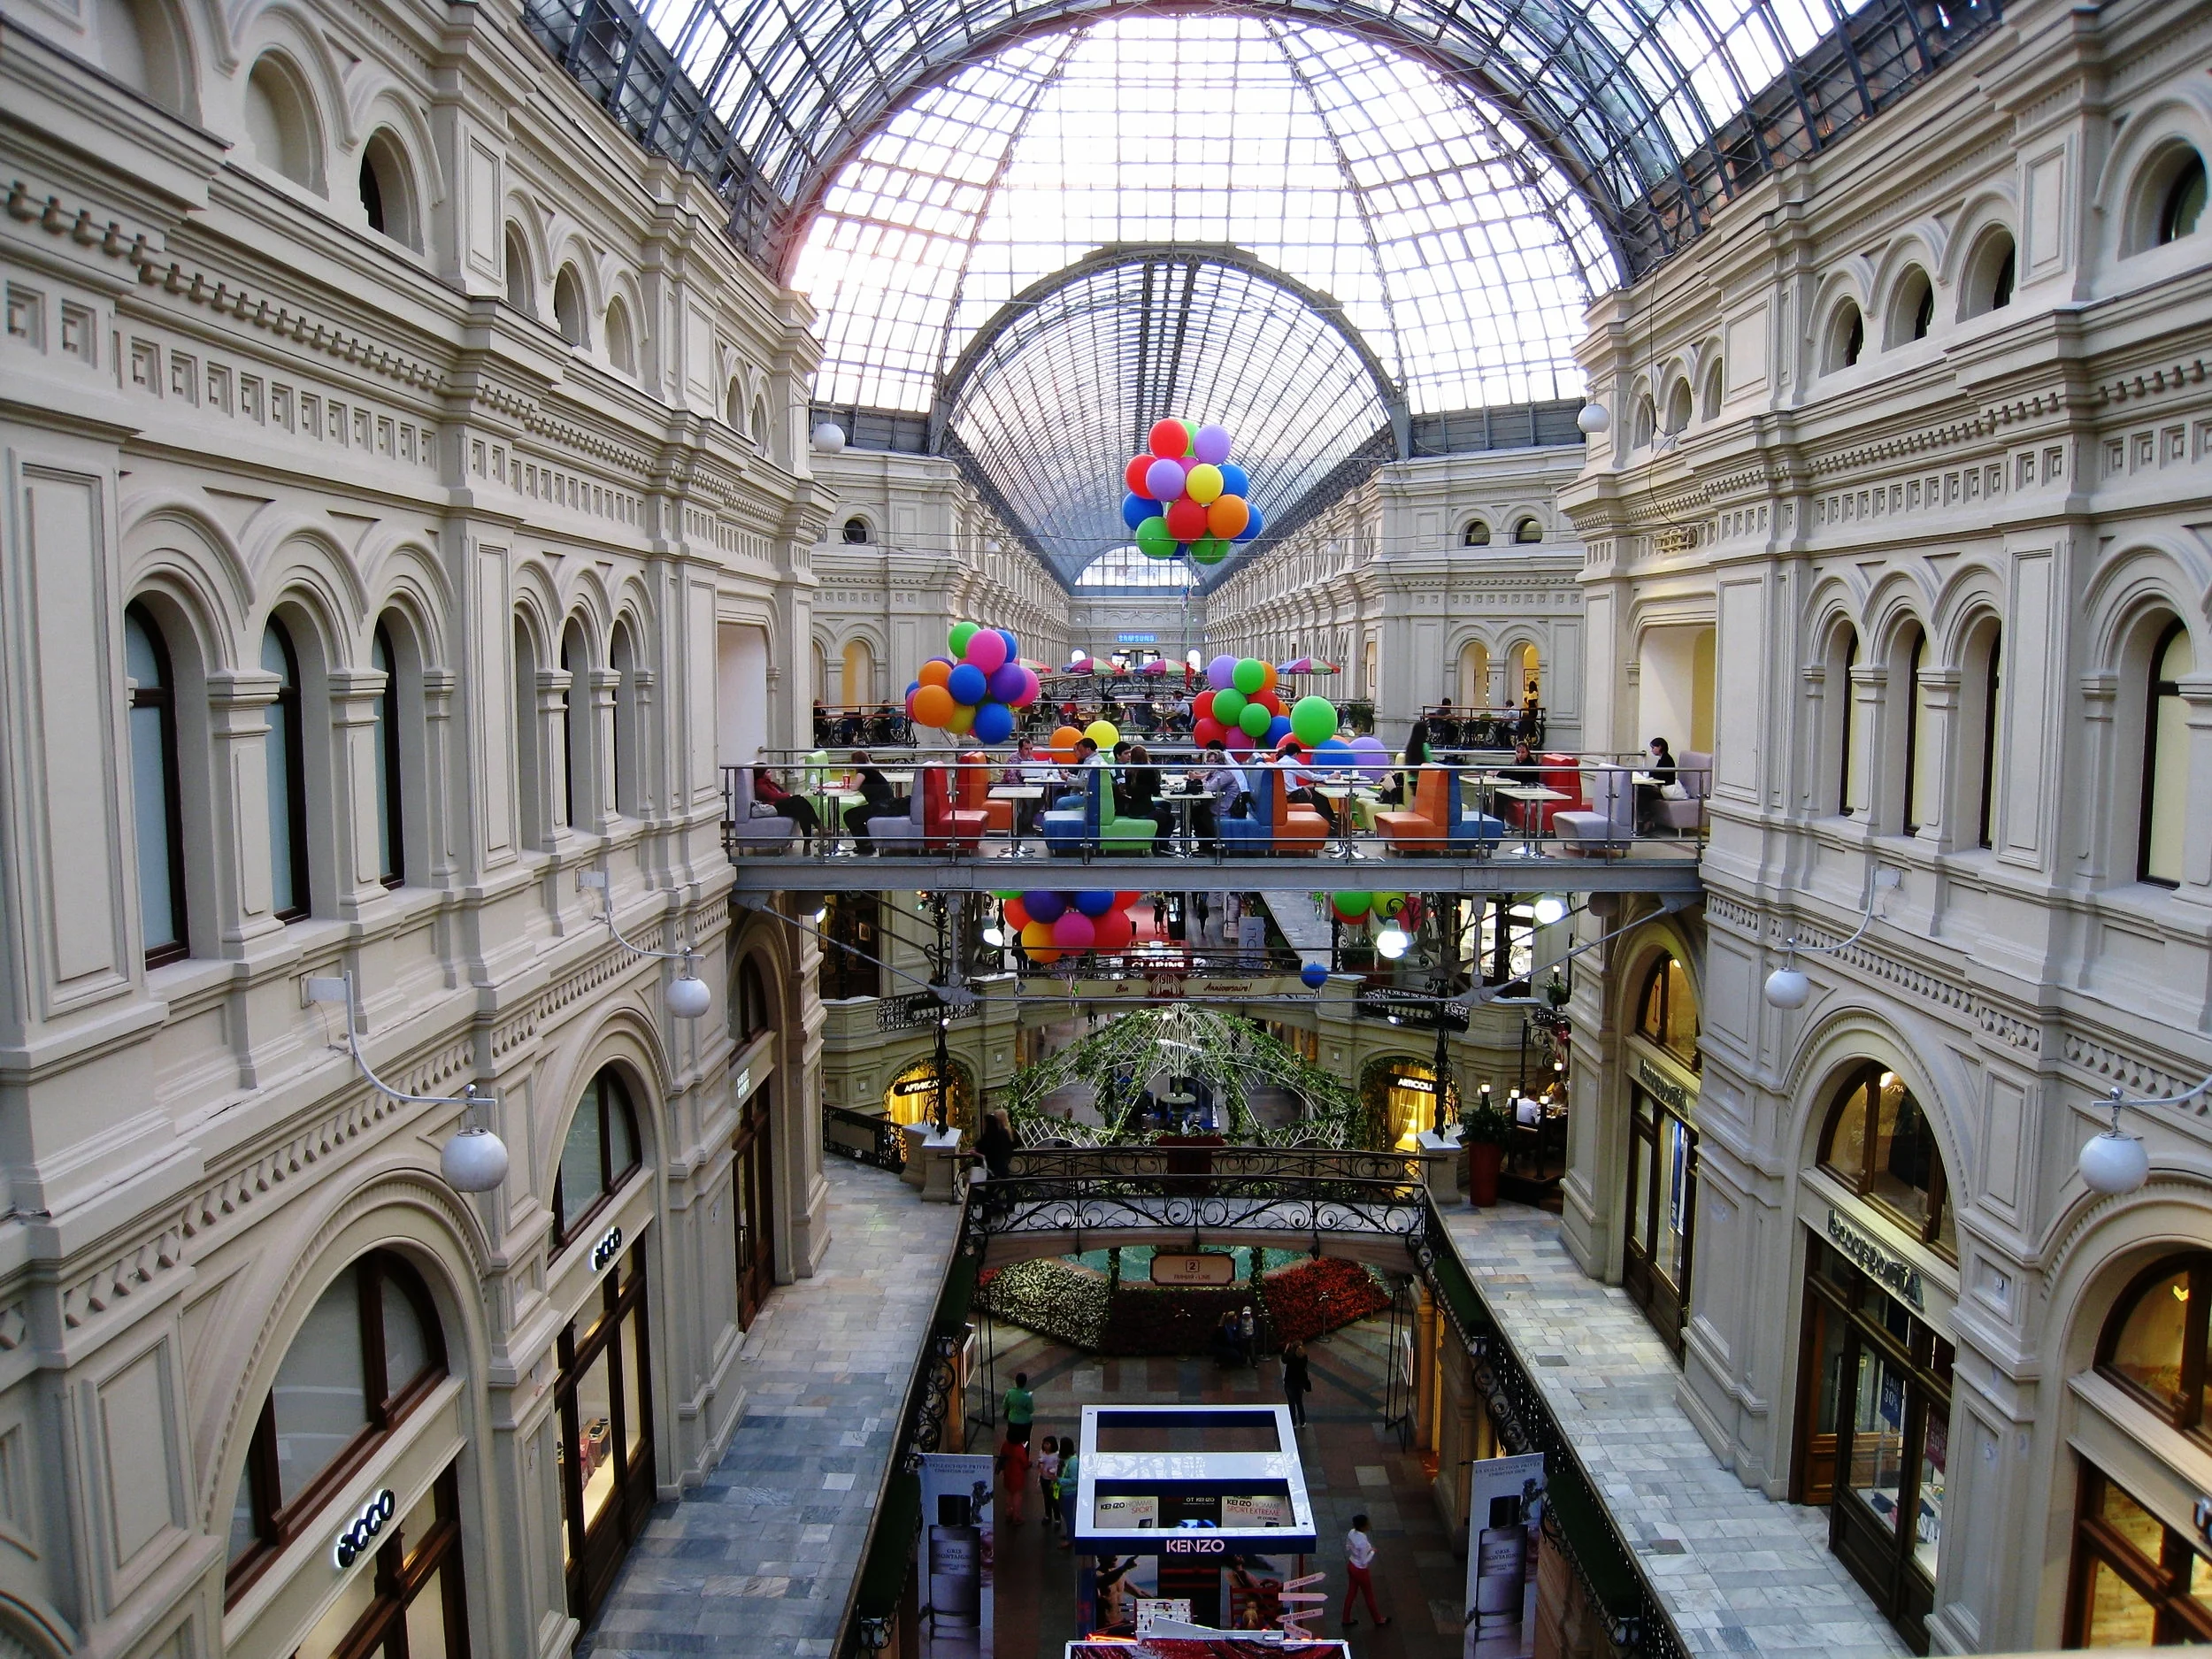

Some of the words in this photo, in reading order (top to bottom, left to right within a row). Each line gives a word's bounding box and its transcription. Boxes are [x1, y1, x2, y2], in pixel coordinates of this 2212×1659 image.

[1115, 983, 1129, 993] Bon
[1203, 982, 1252, 993] Anniversaire!
[1397, 1078, 1432, 1092] ARTICOLI
[591, 1226, 622, 1271] ecco
[1886, 1372, 1900, 1394] SALE
[1100, 1502, 1125, 1510] KENZO
[1132, 1505, 1154, 1514] SPORT
[1249, 1508, 1282, 1517] EXTREME
[335, 1489, 396, 1568] ecco
[1165, 1539, 1225, 1554] KENZO
